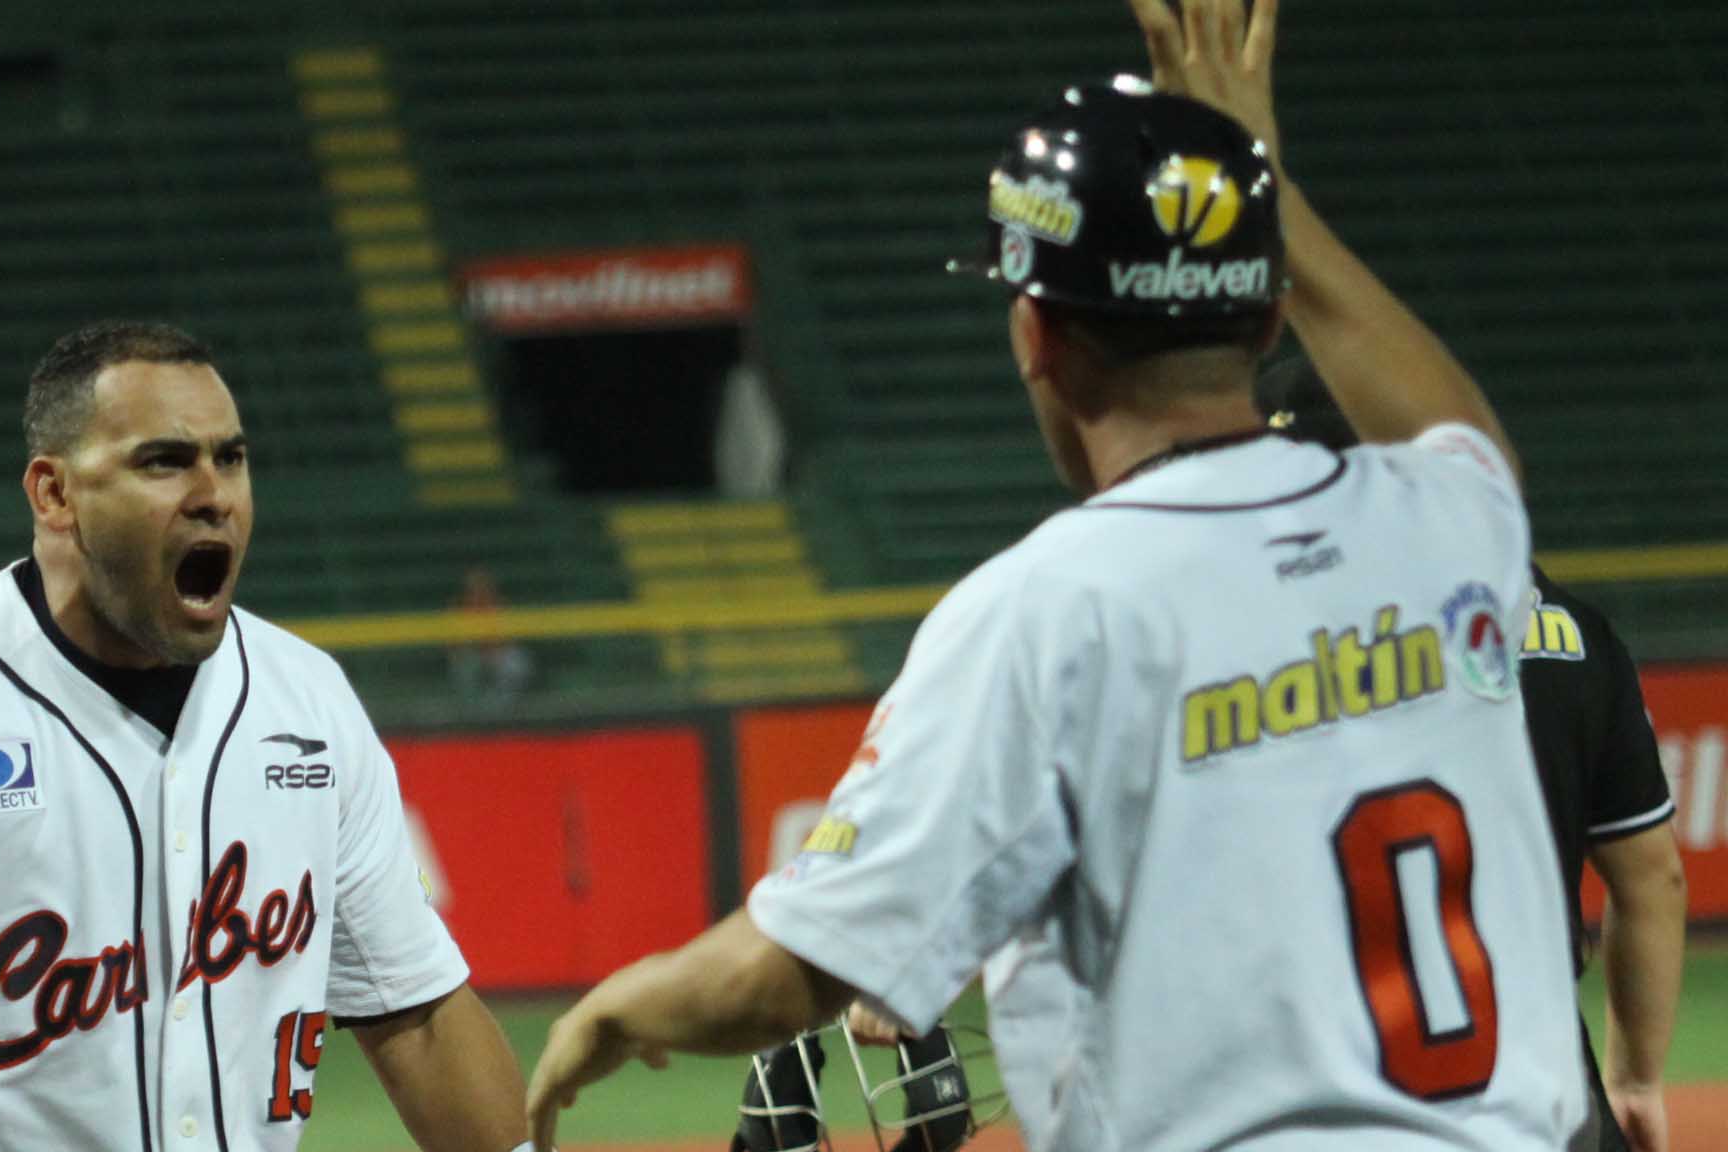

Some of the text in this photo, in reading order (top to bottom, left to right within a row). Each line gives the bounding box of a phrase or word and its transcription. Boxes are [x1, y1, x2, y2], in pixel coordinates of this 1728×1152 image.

[1108, 246, 1270, 299] valeven
[1180, 604, 1446, 764] maltín
[1328, 777, 1500, 1104] 0
